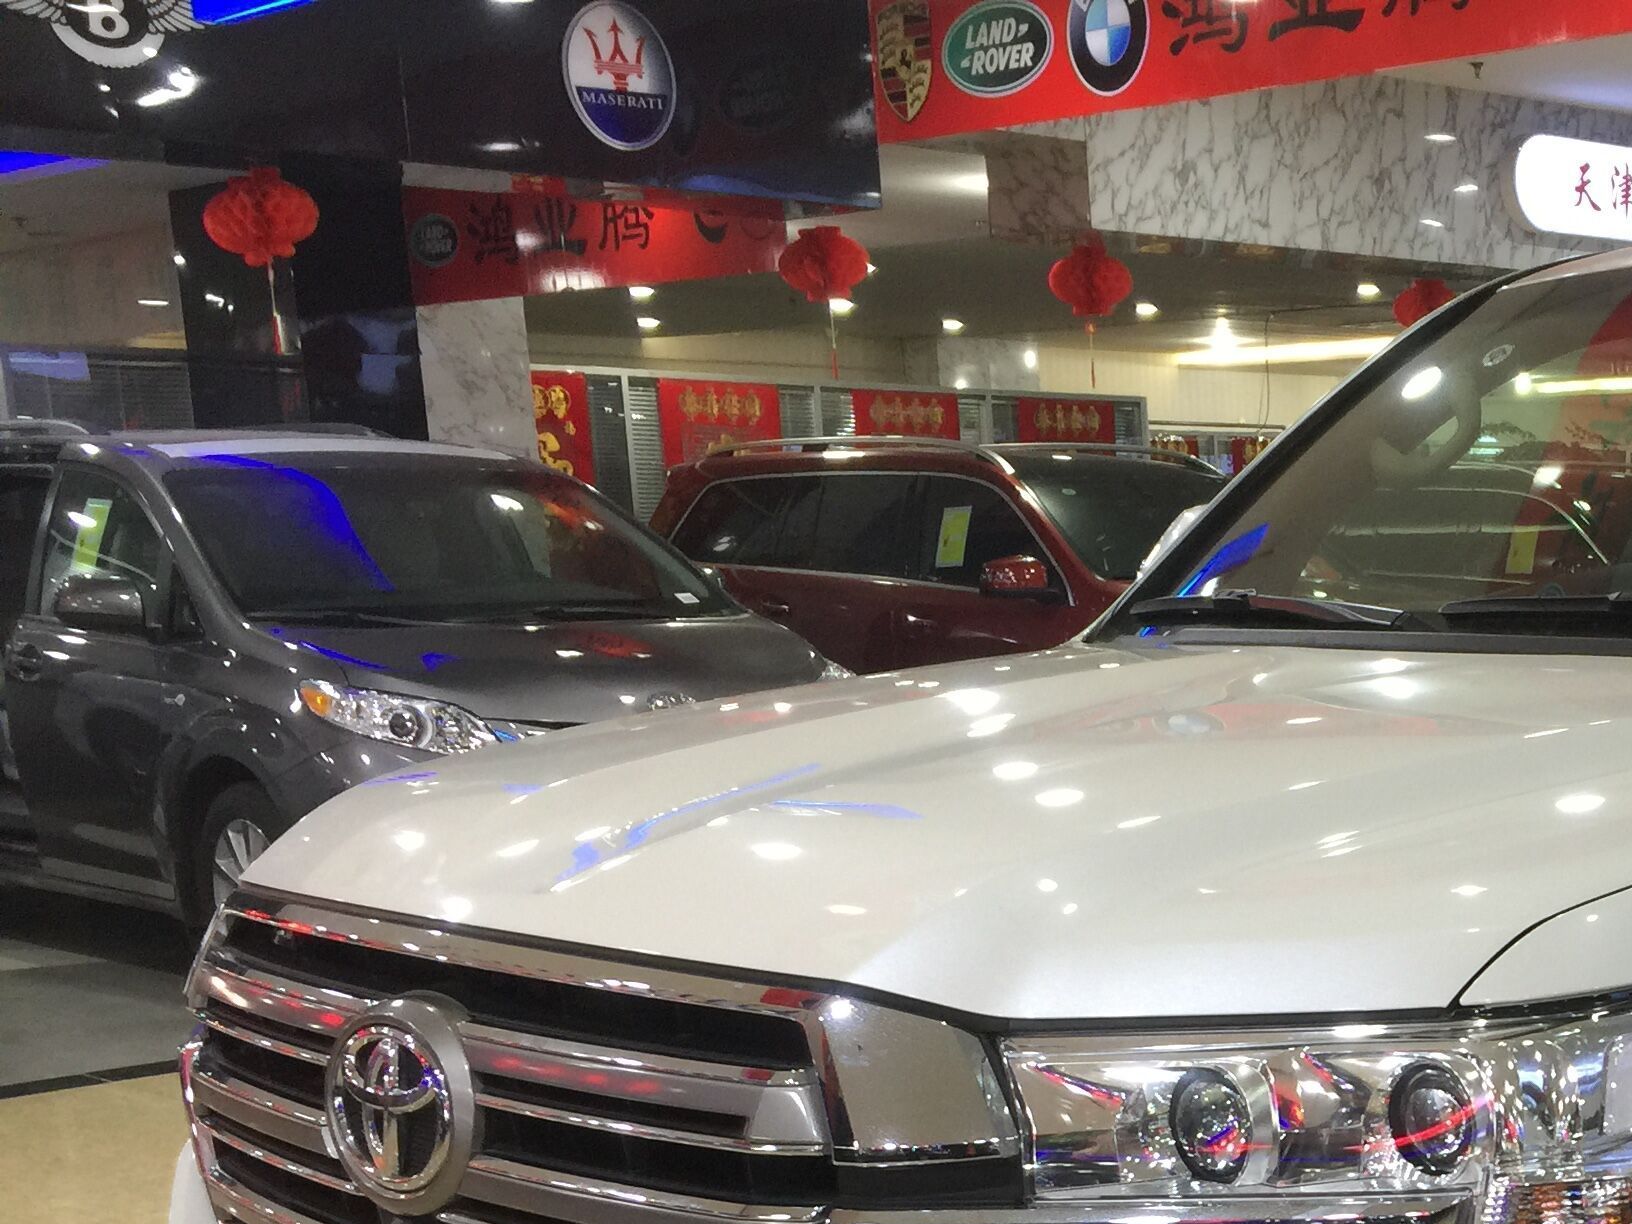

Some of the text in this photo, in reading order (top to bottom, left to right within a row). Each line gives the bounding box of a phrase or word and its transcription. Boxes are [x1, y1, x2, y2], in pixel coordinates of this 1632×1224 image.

[965, 17, 1016, 49] LAND
[971, 42, 1035, 75] ROVER
[581, 90, 664, 110] MASERATI
